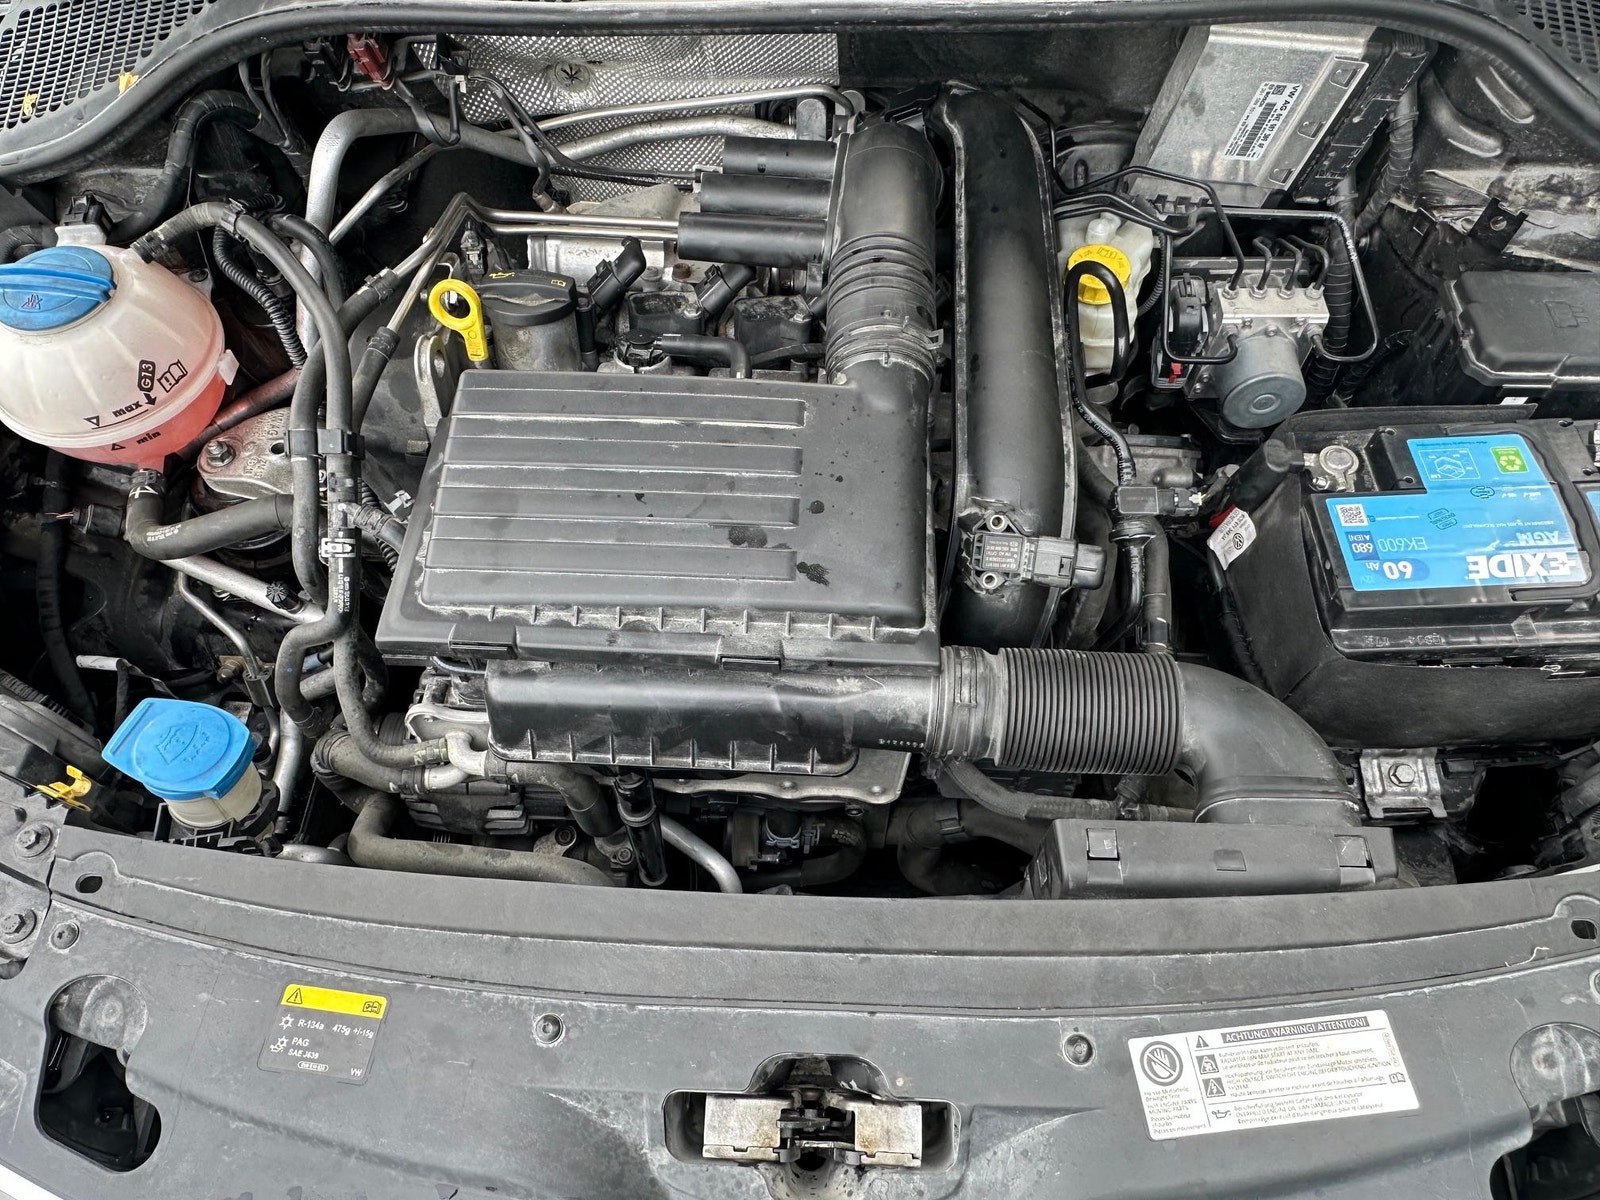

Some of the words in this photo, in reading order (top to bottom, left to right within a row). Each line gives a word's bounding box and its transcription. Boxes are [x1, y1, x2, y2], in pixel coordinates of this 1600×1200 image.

[1288, 85, 1300, 98] VW
[1280, 100, 1290, 111] AG
[142, 364, 153, 388] G13
[112, 400, 143, 418] max
[136, 432, 161, 444] min
[1377, 536, 1428, 552] EK600
[1516, 530, 1559, 546] AGM
[1352, 542, 1374, 554] 680
[1365, 562, 1380, 571] Ah
[1382, 560, 1413, 580] 60
[1466, 552, 1576, 580] EXIDE
[298, 1019, 324, 1030] R-134a
[332, 1024, 351, 1036] 475g
[353, 1028, 374, 1039] +/-15g
[1225, 1029, 1270, 1042] ACHTUNG!
[1271, 1023, 1316, 1036] WARNING!
[1316, 1017, 1366, 1030] ATTENTION!
[292, 1036, 310, 1046] PAG
[288, 1048, 302, 1058] SAE
